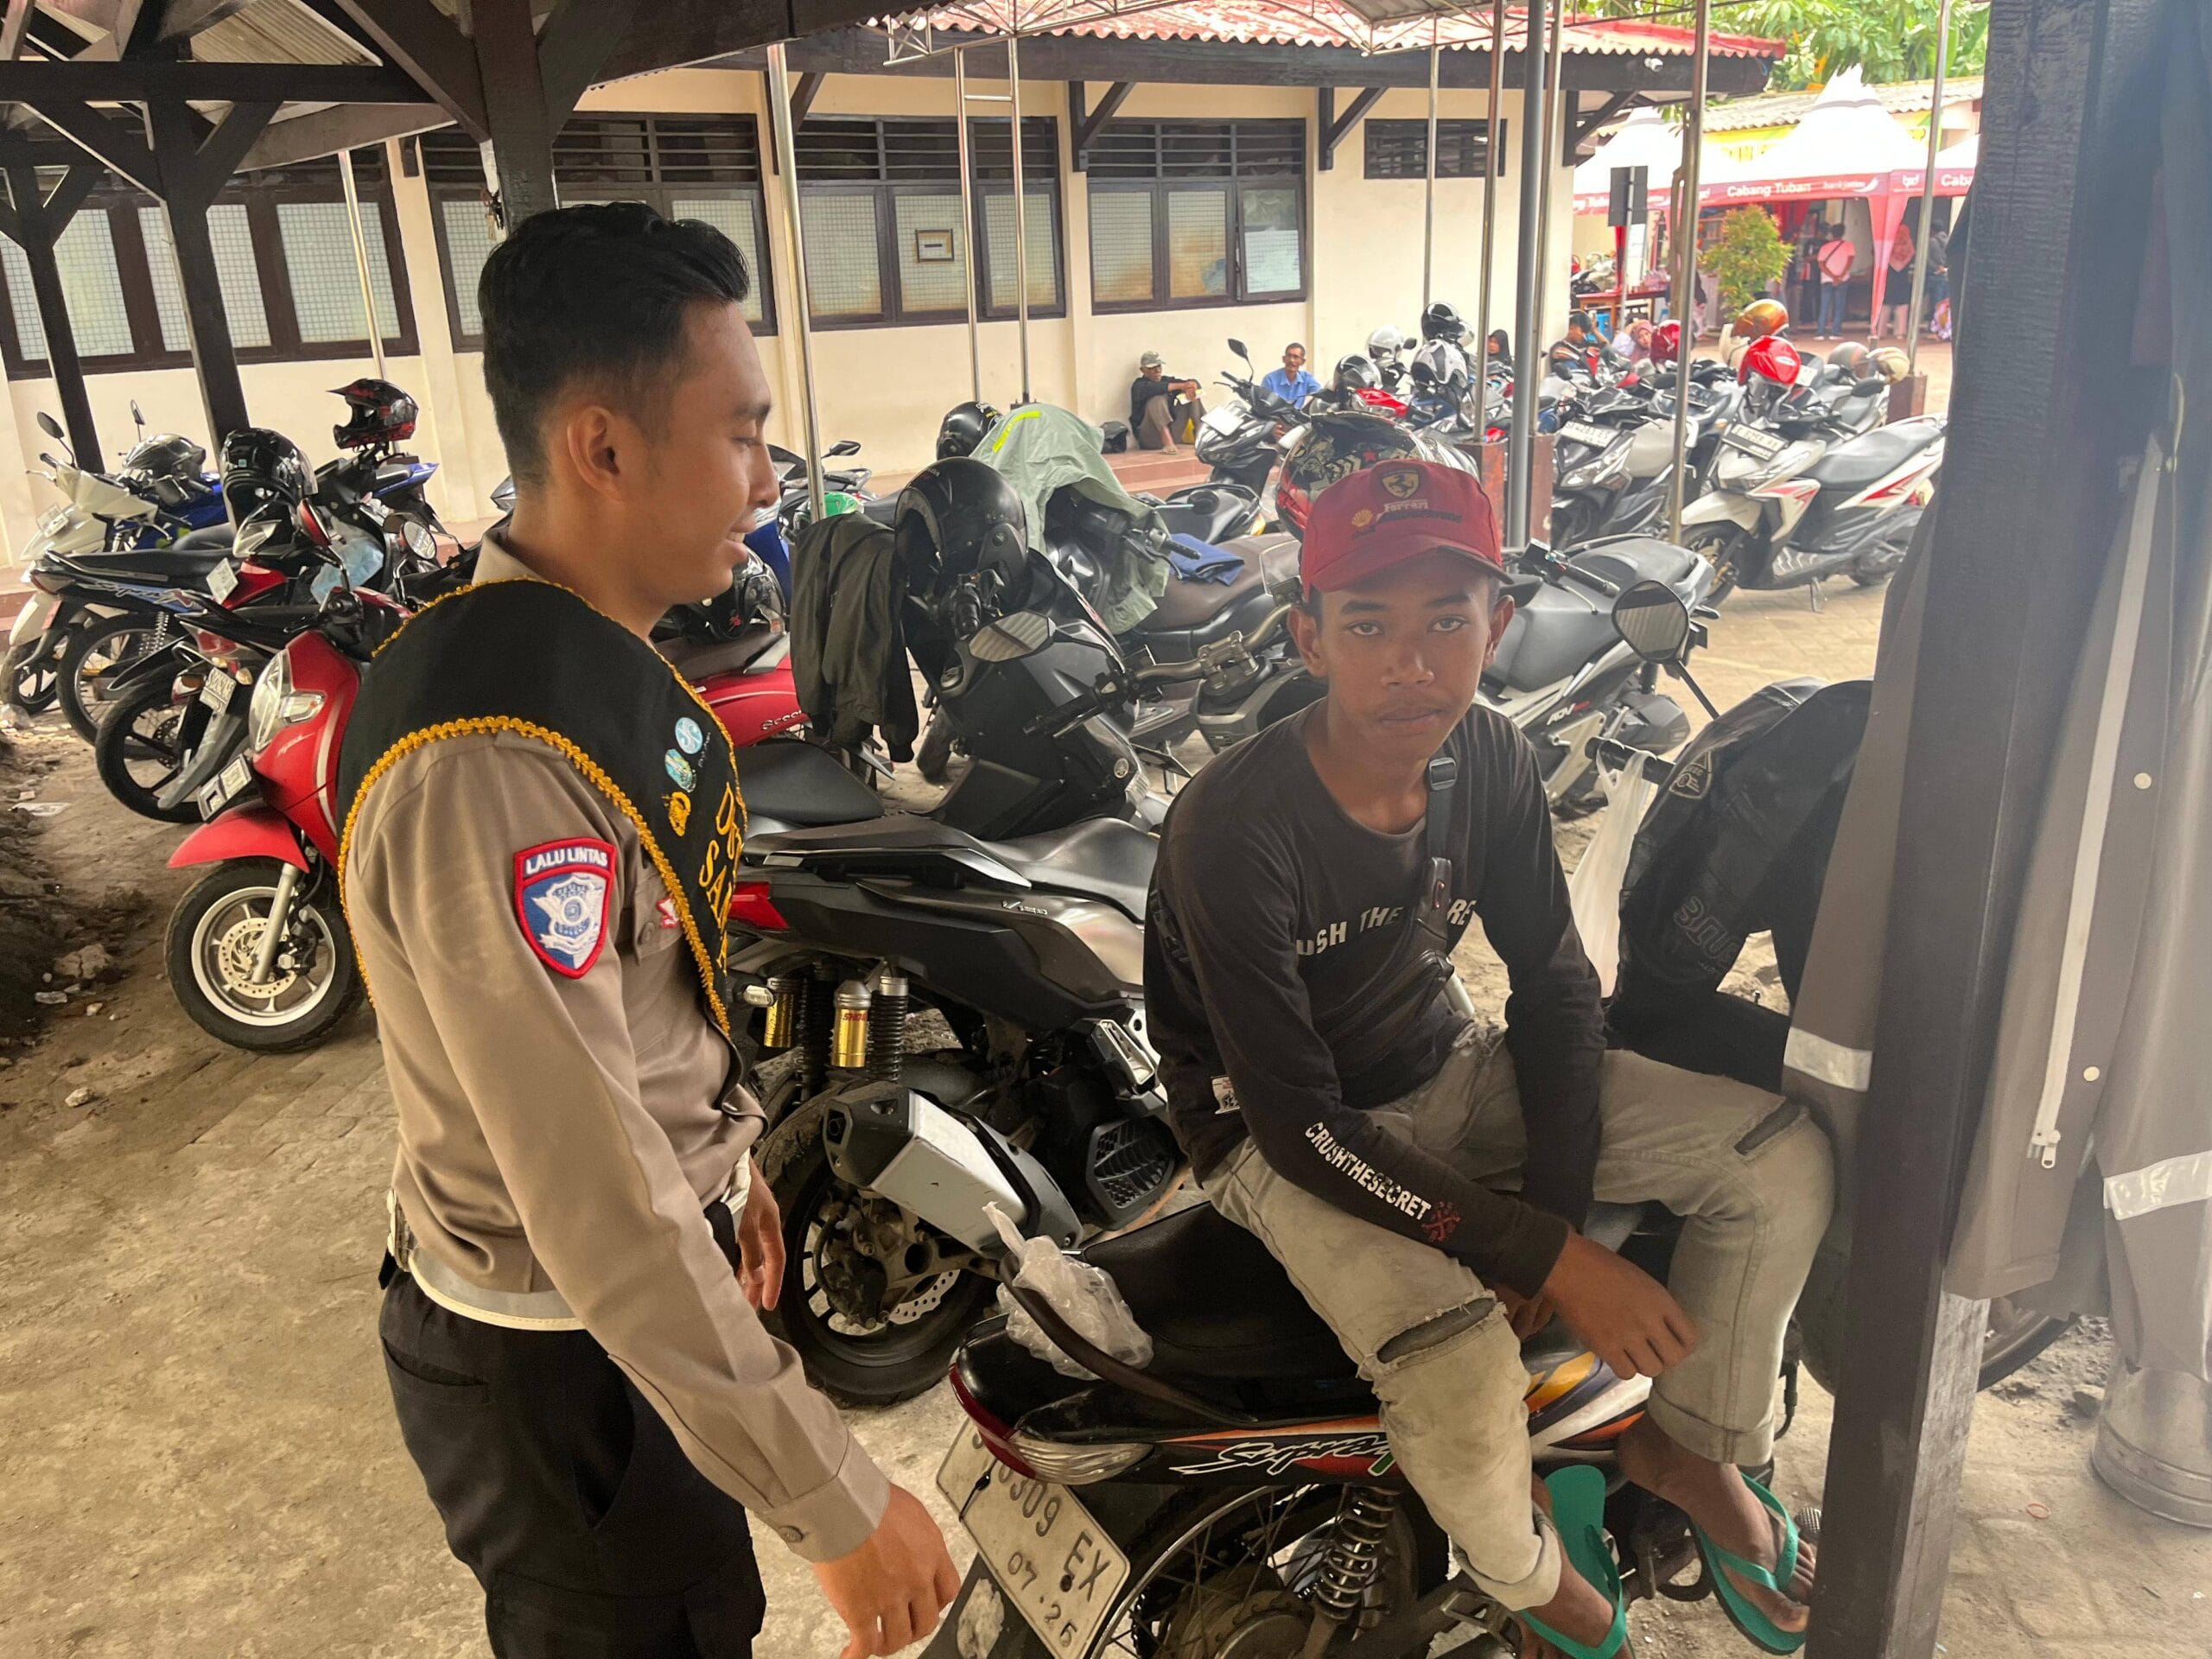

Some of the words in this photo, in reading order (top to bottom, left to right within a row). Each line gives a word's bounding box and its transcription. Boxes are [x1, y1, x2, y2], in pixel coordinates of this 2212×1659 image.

[1726, 185, 1771, 197] Cabang
[1775, 181, 1812, 194] Tuban
[1383, 499, 1429, 512] Ferrari
[761, 709, 802, 731] Scoo
[524, 848, 565, 874] LALU
[566, 846, 608, 867] LINTAS
[1359, 906, 1405, 933] THE
[1304, 1121, 1433, 1221] CRUSHTHESECRET
[1063, 1530, 1111, 1602] EX
